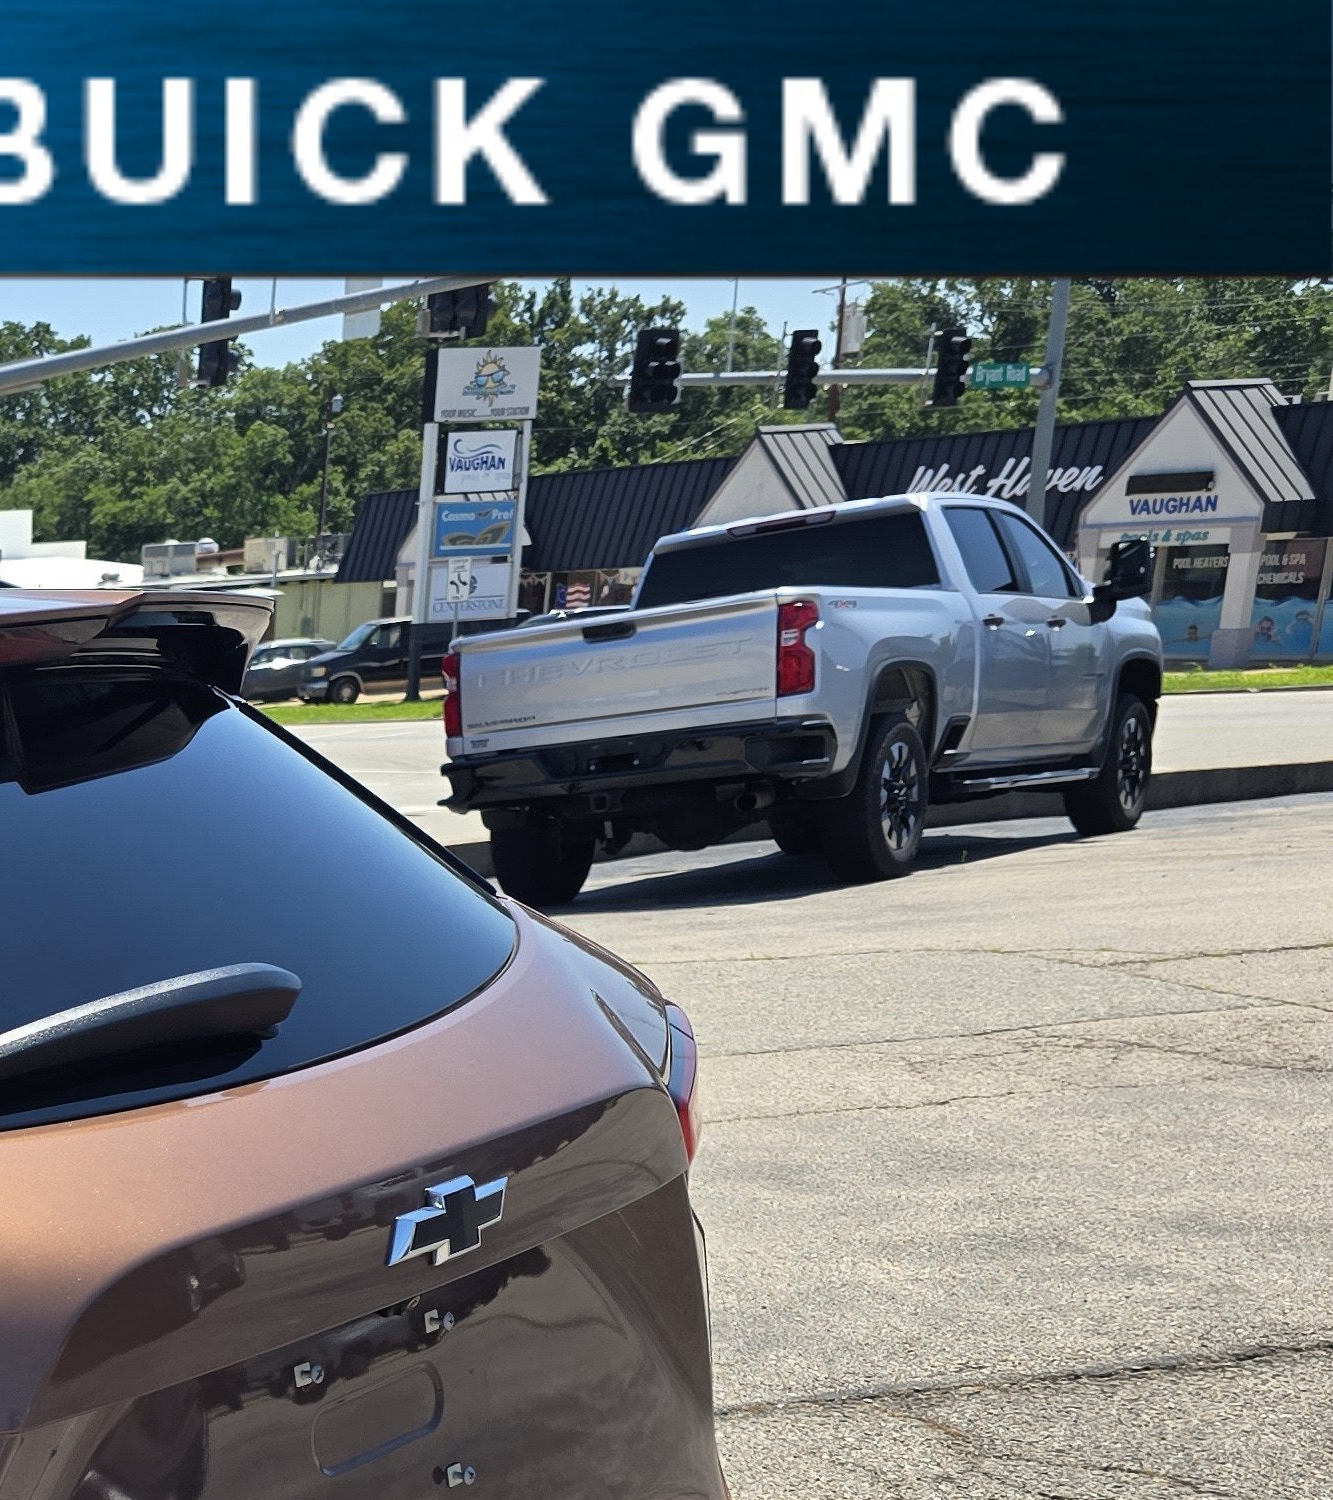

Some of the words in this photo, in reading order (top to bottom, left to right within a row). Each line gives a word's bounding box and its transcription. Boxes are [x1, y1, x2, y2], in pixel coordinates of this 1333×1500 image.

[975, 364, 1004, 385] Bryant
[1006, 365, 1027, 383] Road
[448, 455, 506, 472] VAUGHAN
[907, 463, 987, 494] West
[986, 456, 1104, 500] Haven
[1128, 495, 1218, 516] VAUGHAN
[491, 508, 514, 520] Prof
[1175, 529, 1210, 544] spas
[1172, 557, 1193, 569] POOL
[1193, 556, 1229, 568] HEATERS
[1260, 554, 1280, 566] POOL
[1257, 571, 1305, 585] CHEMICALS
